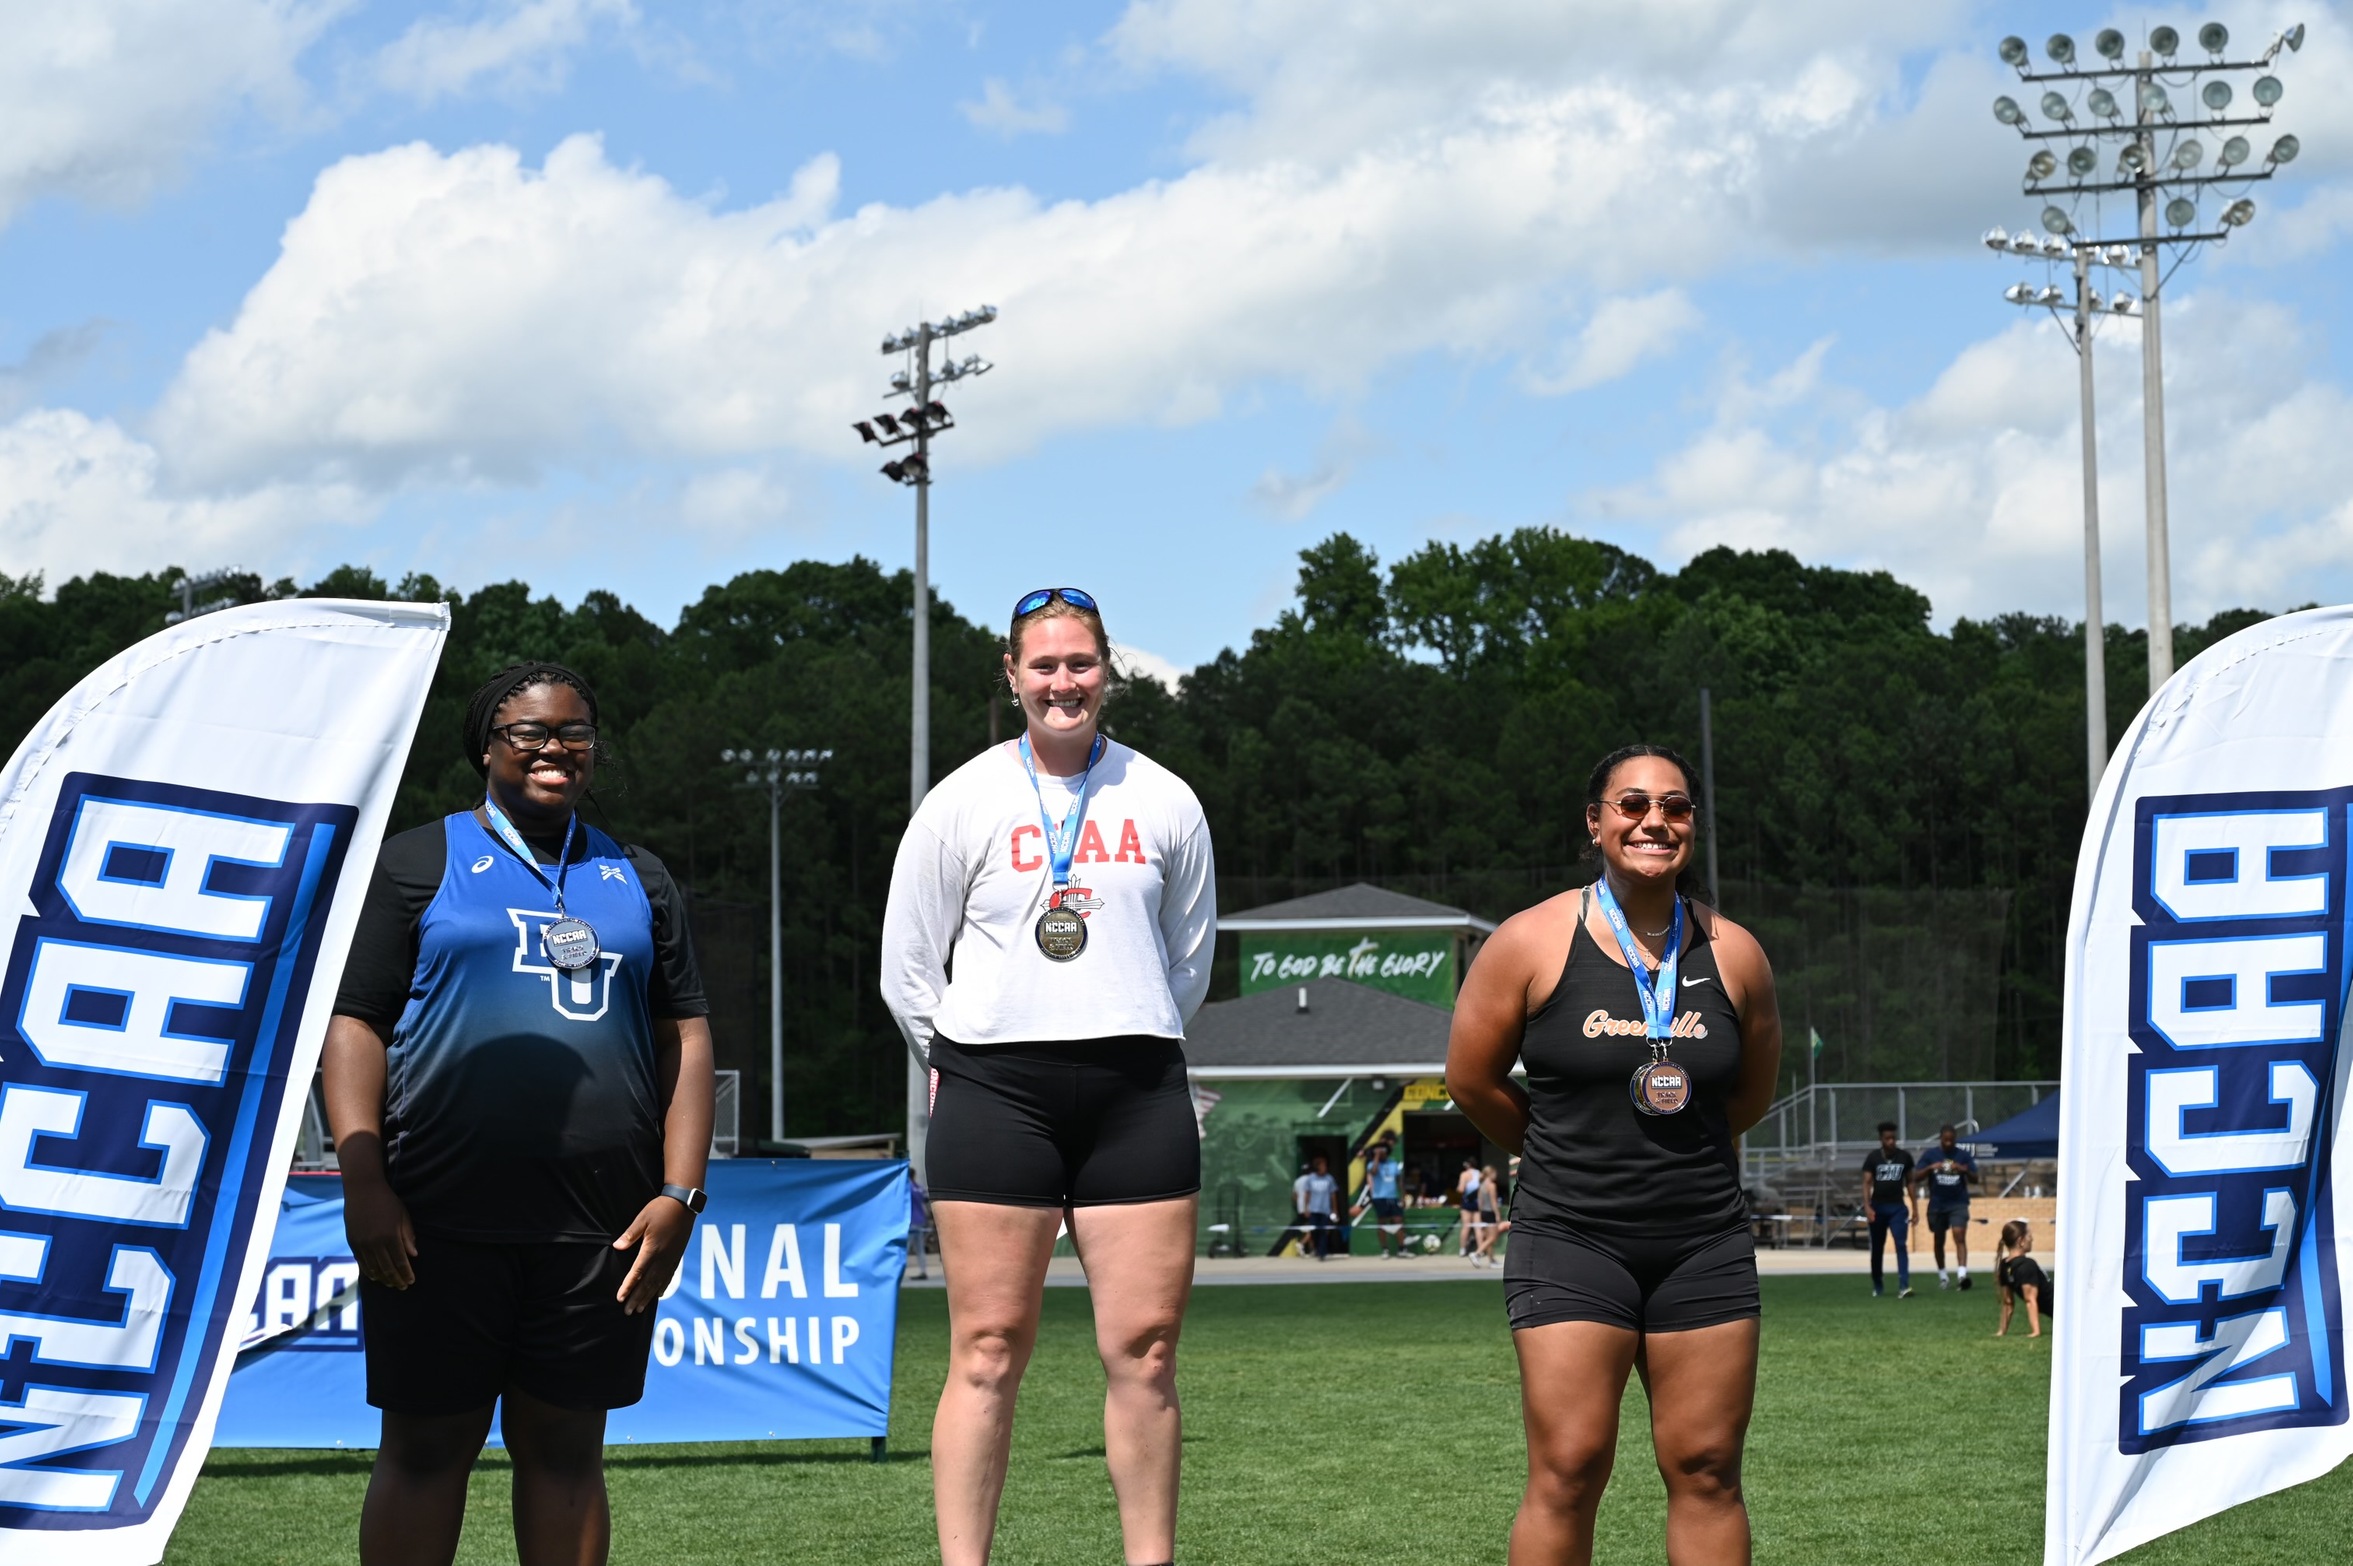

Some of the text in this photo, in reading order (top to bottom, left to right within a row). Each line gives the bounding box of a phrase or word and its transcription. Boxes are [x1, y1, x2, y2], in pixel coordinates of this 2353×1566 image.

[1011, 819, 1146, 873] CAA
[553, 930, 587, 945] NCCAA
[1045, 922, 1077, 933] NCCAA
[1251, 952, 1277, 982] TO
[1278, 954, 1318, 980] GOD
[1319, 953, 1346, 978] BE
[1380, 950, 1446, 979] GLORY
[1626, 944, 1641, 968] NCCAA
[1651, 1076, 1681, 1087] NCCAA
[2138, 807, 2329, 1435] NCCAA
[0, 794, 295, 1511] NCCAA
